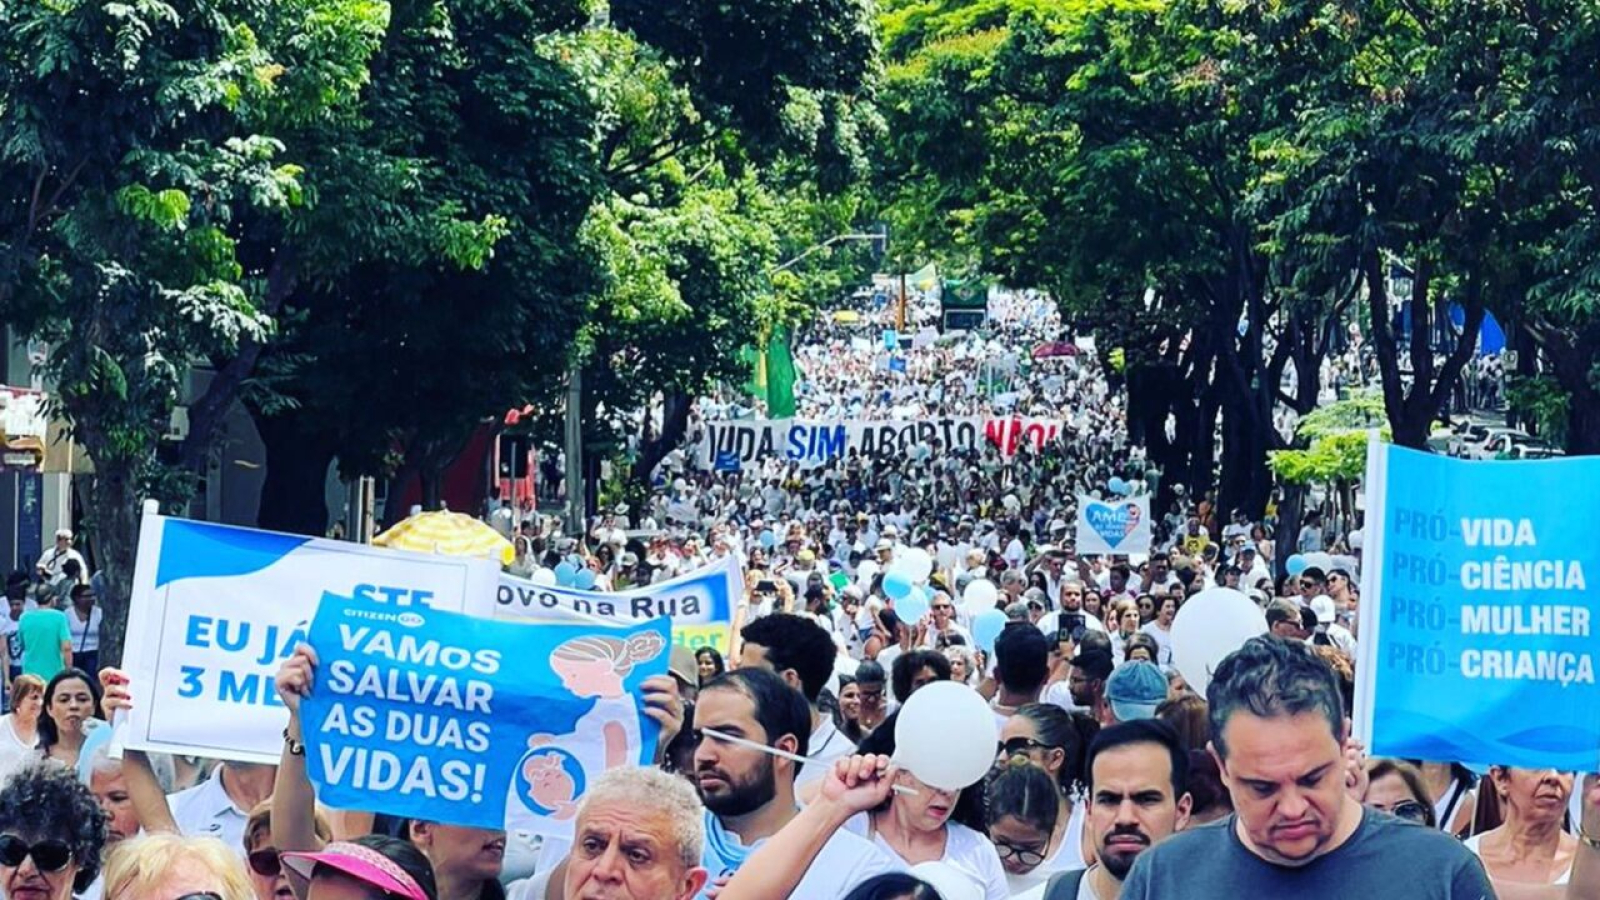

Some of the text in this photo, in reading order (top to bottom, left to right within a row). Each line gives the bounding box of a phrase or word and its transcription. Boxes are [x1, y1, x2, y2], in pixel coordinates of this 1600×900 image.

[708, 424, 774, 463] VIDA
[785, 424, 846, 461] SIM
[496, 585, 701, 618] ovo na Rua
[185, 614, 308, 665] EU JÁ
[339, 624, 502, 675] VAMOS
[671, 629, 723, 651] der
[177, 665, 284, 707] 3 ME
[327, 659, 494, 715] SALVAR
[320, 702, 491, 752] AS DUAS
[319, 743, 487, 804] VIDAS!
